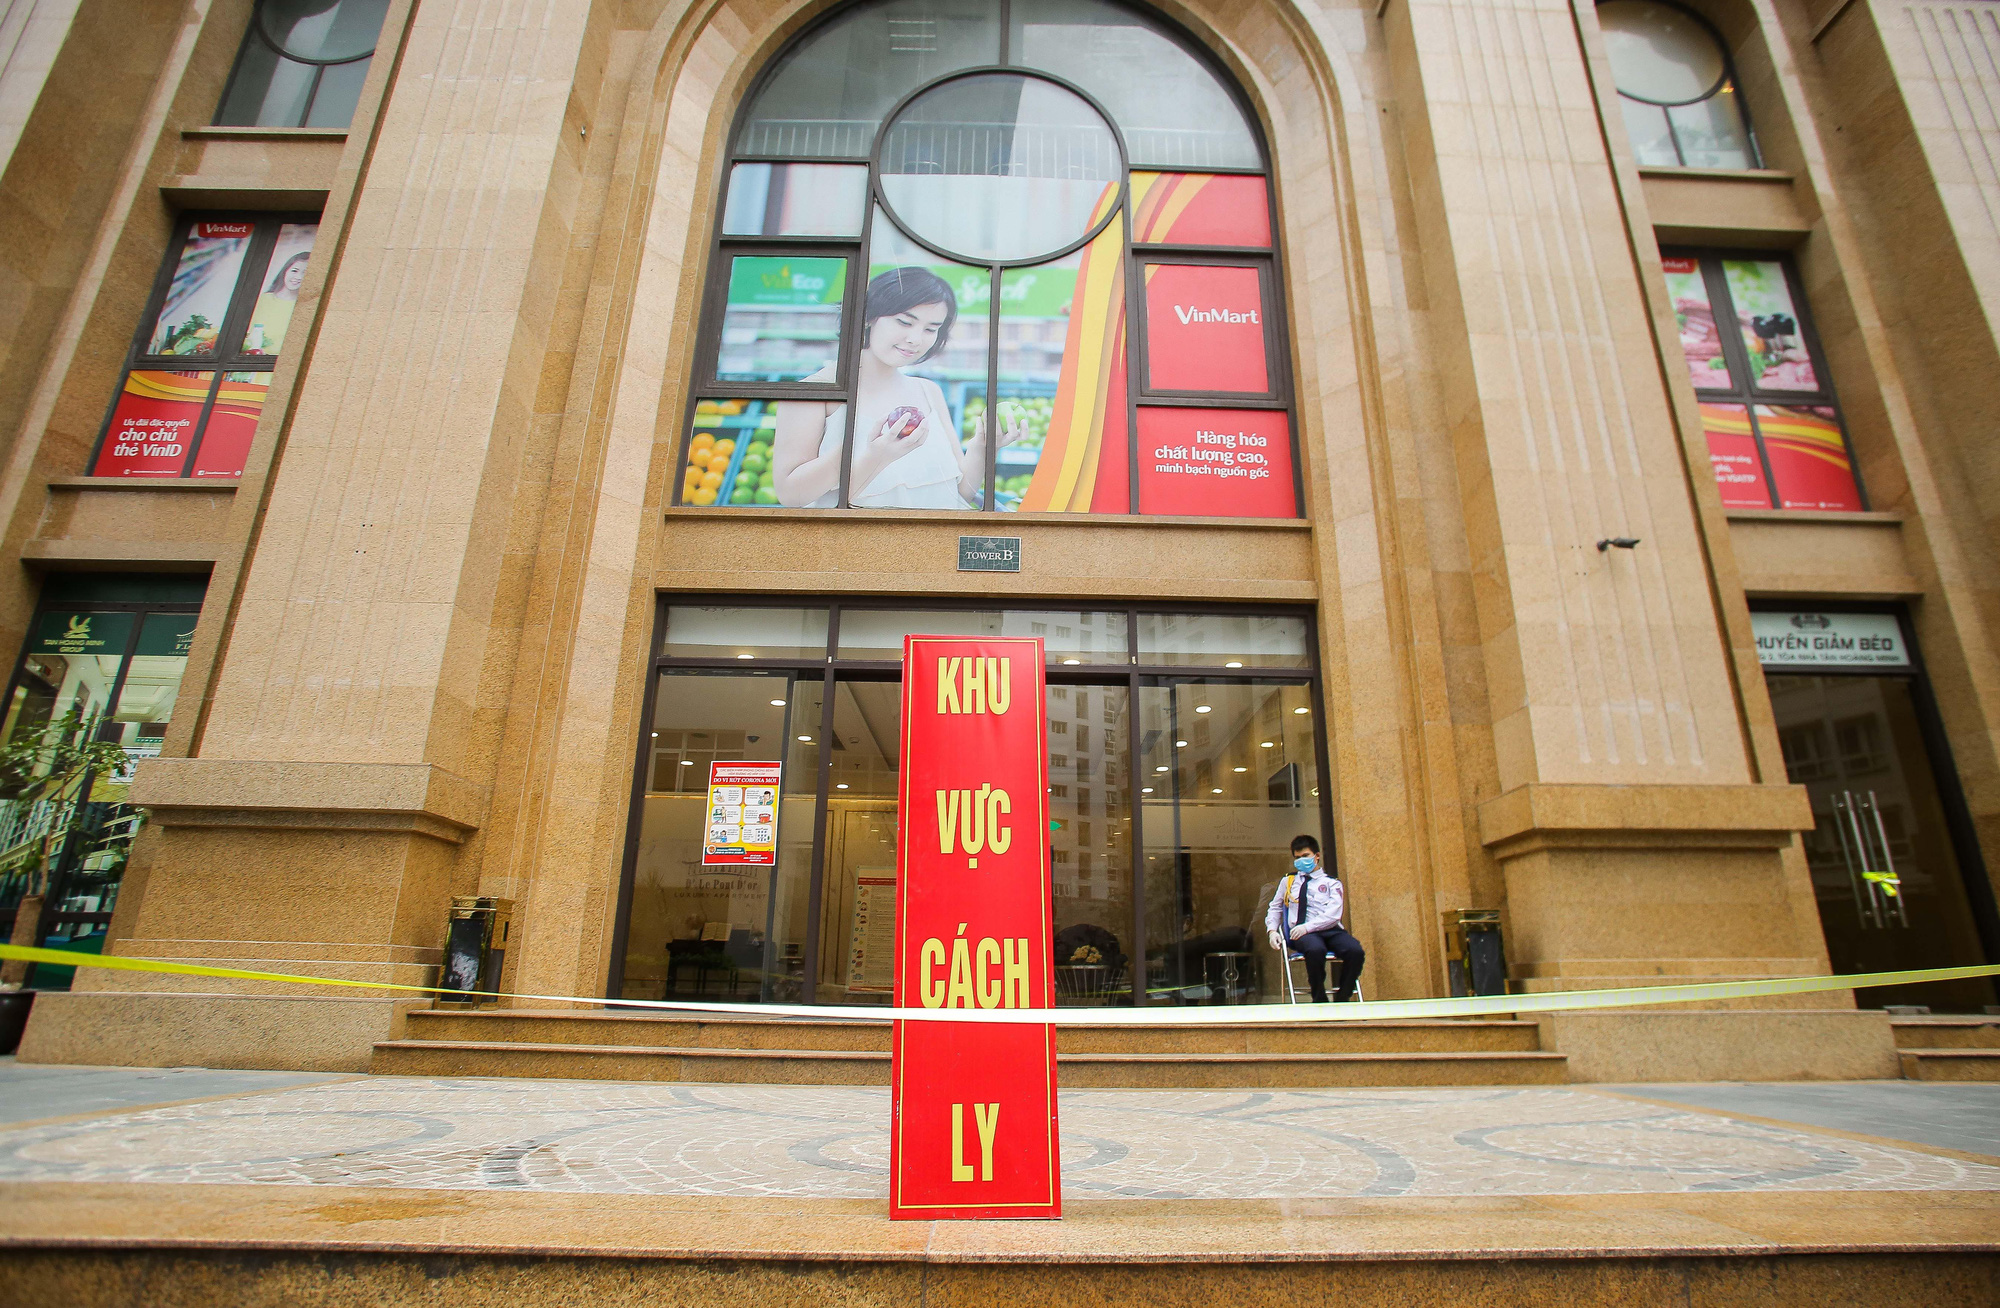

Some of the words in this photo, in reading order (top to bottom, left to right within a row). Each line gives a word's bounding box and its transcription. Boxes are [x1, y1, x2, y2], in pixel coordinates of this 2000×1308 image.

[206, 223, 247, 234] VinMart
[1174, 304, 1260, 325] VinMart
[118, 427, 147, 441] cho
[1196, 430, 1237, 449] Hàng
[1239, 431, 1268, 448] hóa
[113, 442, 140, 457] thẻ
[142, 443, 183, 457] VinID
[1154, 445, 1188, 460] chất
[1191, 446, 1235, 466] lượng
[1236, 451, 1269, 466] cao,
[1155, 463, 1183, 474] minh
[1185, 463, 1212, 476] bạch
[1213, 465, 1248, 478] nguồn
[1249, 466, 1270, 480] gốc
[965, 551, 1002, 560] TOWER
[1003, 549, 1014, 561] B
[1813, 632, 1854, 651] GIẢM
[1859, 633, 1893, 651] BÉO
[936, 656, 1011, 715] KHU
[935, 782, 1012, 869] VỰC
[713, 879, 734, 890] Pont
[919, 922, 1030, 1009] CÁCH
[951, 1103, 1000, 1182] LY
